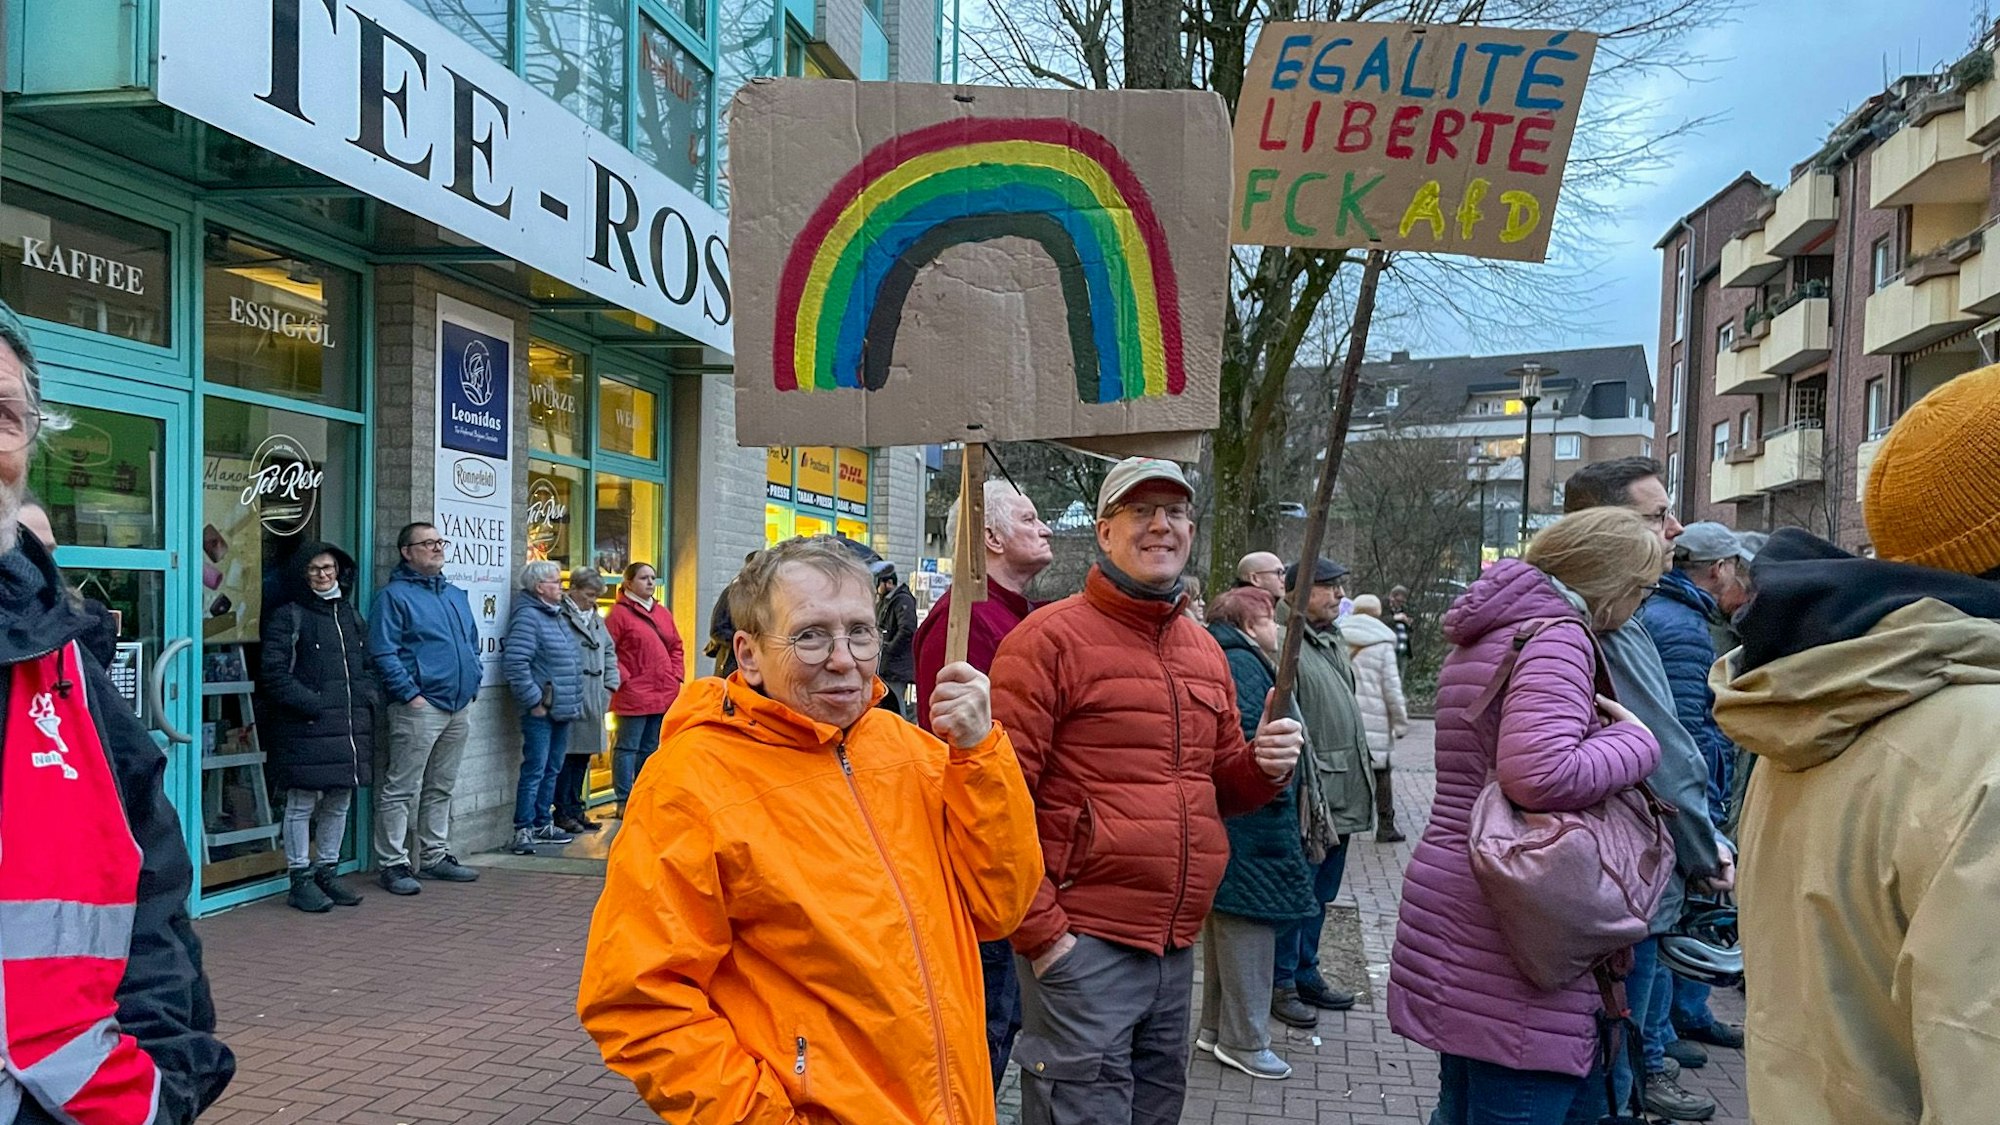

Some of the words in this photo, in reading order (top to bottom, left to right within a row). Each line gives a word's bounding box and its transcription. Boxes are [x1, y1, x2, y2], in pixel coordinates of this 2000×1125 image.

[1270, 31, 1580, 110] EGALITÉ
[253, 0, 514, 221] TEE
[1258, 98, 1556, 175] LIBERTÉ
[1241, 168, 1386, 241] FCK
[1399, 178, 1541, 244] AfD
[21, 235, 145, 296] KAFFEE
[452, 403, 501, 431] Leonidas
[240, 464, 281, 506] Tee
[280, 461, 325, 501] Rose
[770, 485, 790, 500] PRESSE
[839, 463, 863, 484] DHL
[440, 513, 505, 542] YANKEE
